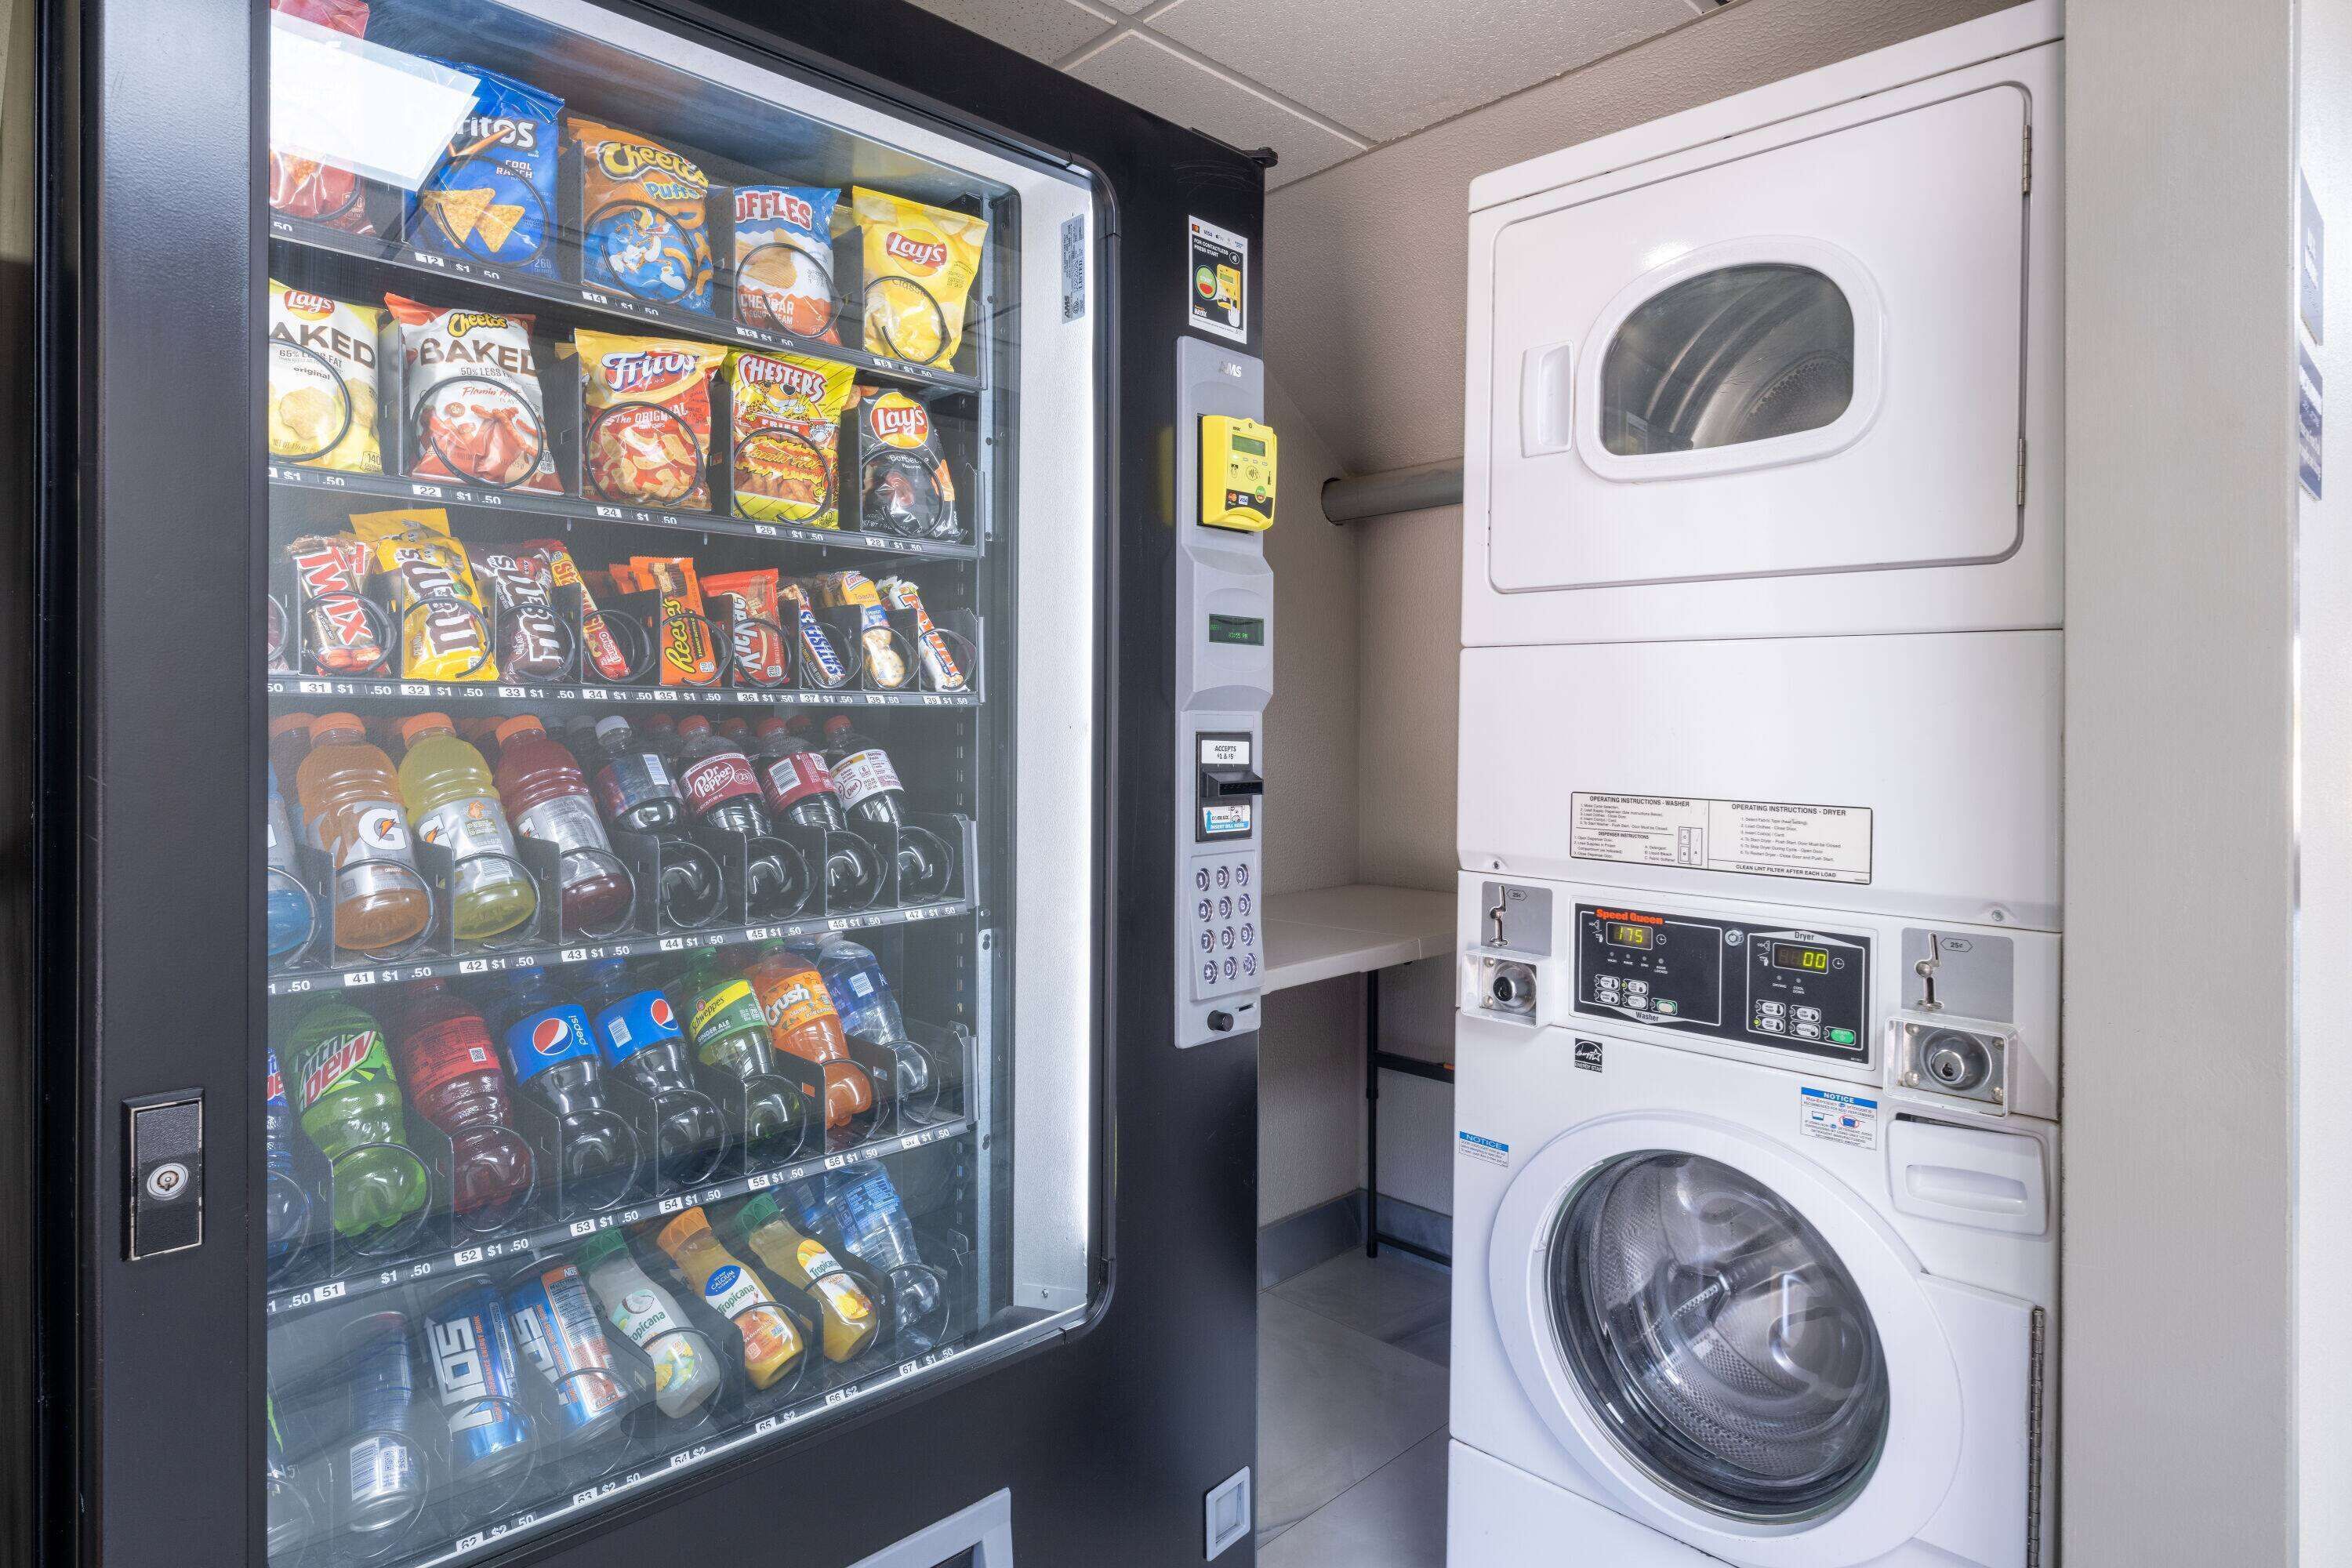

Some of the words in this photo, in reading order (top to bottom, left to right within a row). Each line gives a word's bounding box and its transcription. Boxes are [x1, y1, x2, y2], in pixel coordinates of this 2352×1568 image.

[455, 117, 534, 148] ritos
[495, 167, 533, 179] RACH
[735, 192, 812, 230] UFFLES
[889, 234, 945, 264] Lay's
[1193, 238, 1202, 246] FOR
[1202, 240, 1229, 256] CONTACTLESS
[1194, 244, 1206, 255] PRESS
[1205, 249, 1219, 258] START
[286, 289, 333, 314] Lay's
[448, 312, 508, 337] Cheetos
[269, 321, 376, 369] AKED
[328, 354, 343, 368] FAT
[419, 337, 536, 376] BAKED
[293, 366, 330, 380] original
[460, 367, 478, 376] 50%
[480, 367, 502, 376] LESS
[602, 351, 699, 391] Fritos
[739, 354, 829, 403] CHESTER'S
[615, 415, 632, 424] The
[761, 418, 800, 432] FRIES
[877, 406, 926, 436] Lay's
[889, 454, 930, 464] Barbece
[419, 486, 437, 495] 22
[456, 491, 472, 501] $1
[481, 496, 502, 505] .50
[602, 507, 617, 516] 24
[637, 513, 649, 521] $1
[760, 526, 773, 535] 26
[791, 530, 804, 539] $1
[296, 546, 375, 646] TWIX
[599, 630, 622, 663] Original
[309, 683, 326, 692] 31
[337, 684, 354, 695] $1
[370, 685, 392, 695] .50
[408, 685, 426, 695] 32
[437, 686, 452, 697] $1
[464, 688, 483, 697] .50
[659, 691, 673, 700] 35
[684, 692, 696, 701] $1
[695, 766, 733, 798] Pepper
[702, 765, 719, 782] Dr
[739, 772, 749, 781] 23
[846, 782, 859, 797] Diet
[1621, 797, 1661, 806] INSTRUCTIONS
[1769, 805, 1817, 815] INSTRUCTIONS
[358, 808, 408, 850] G
[1595, 908, 1628, 922] Speed
[1629, 912, 1664, 925] Queen
[751, 929, 764, 939] 45
[770, 927, 782, 938] $1
[786, 926, 802, 936] .50
[1618, 926, 1642, 943] 175
[1795, 931, 1814, 941] Dryer
[665, 938, 679, 949] 44
[686, 935, 699, 948] $1
[707, 935, 724, 946] .50
[466, 960, 483, 971] 42
[492, 959, 506, 971] $1
[515, 956, 535, 967] .50
[352, 973, 369, 983] 41
[383, 970, 398, 982] $1
[411, 967, 432, 978] .50
[764, 983, 811, 1027] Crush
[691, 995, 725, 1033] Schweppes
[1635, 1011, 1659, 1022] Washer
[568, 1014, 589, 1046] pepsi
[697, 1024, 719, 1043] GINGER
[717, 1018, 731, 1033] ALE
[1574, 1062, 1590, 1070] ENERGY
[1824, 1092, 1855, 1104] NOTICE
[1466, 1134, 1503, 1149] NOTICE
[753, 1176, 766, 1187] 55
[771, 1171, 785, 1184] $1
[789, 1167, 804, 1179] .50
[575, 1221, 590, 1233] 53
[600, 1215, 613, 1229] $1
[622, 1210, 639, 1223] .50
[460, 1250, 478, 1262] 52
[487, 1244, 503, 1258] $1
[510, 1238, 529, 1252] .50
[810, 1260, 840, 1277] Tropicana
[711, 1269, 735, 1290] CALCIUM
[717, 1284, 755, 1315] Tropicana
[628, 1311, 666, 1341] ropicana
[902, 1363, 914, 1374] 67
[926, 1353, 936, 1366] $1
[941, 1348, 953, 1360] .50
[829, 1393, 841, 1404] 66
[845, 1385, 858, 1397] $2
